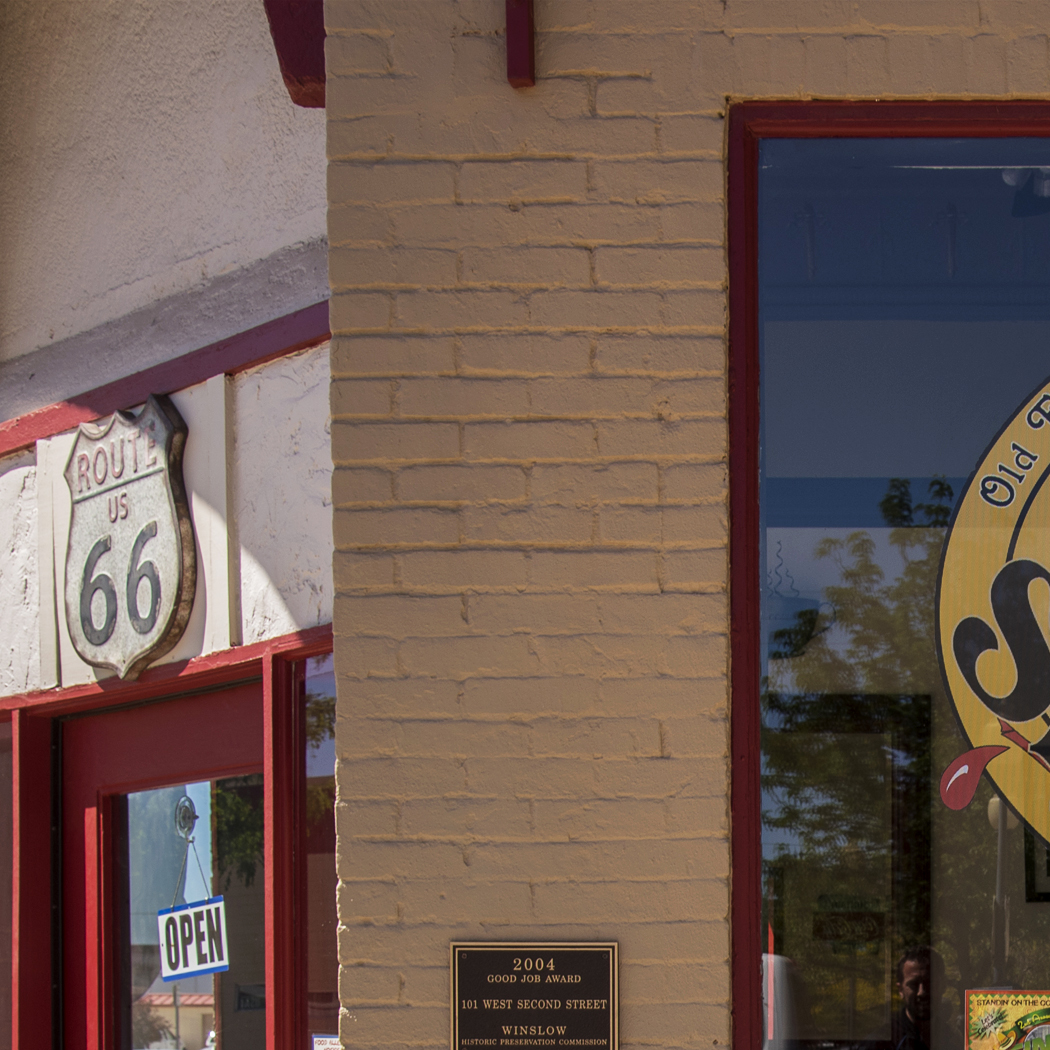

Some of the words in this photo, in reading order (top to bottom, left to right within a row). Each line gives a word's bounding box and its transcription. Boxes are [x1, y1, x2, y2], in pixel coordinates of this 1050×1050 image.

[76, 423, 158, 493] ROUTE
[979, 441, 1039, 508] Old
[108, 492, 129, 523] US
[80, 520, 162, 646] 66
[165, 906, 224, 971] OPEN
[513, 957, 556, 971] 2004
[487, 974, 517, 984] GOOD
[520, 974, 541, 984] JOB
[545, 974, 582, 984] AWARD
[461, 999, 478, 1010] 101
[483, 999, 513, 1010] WEST
[517, 999, 562, 1010] SECOND
[565, 999, 608, 1010] STREET
[501, 1025, 567, 1036] WINSLOW
[461, 1038, 497, 1046] HISTORIC
[500, 1038, 556, 1046] PRESERVATION
[559, 1038, 608, 1046] COMMISSION
